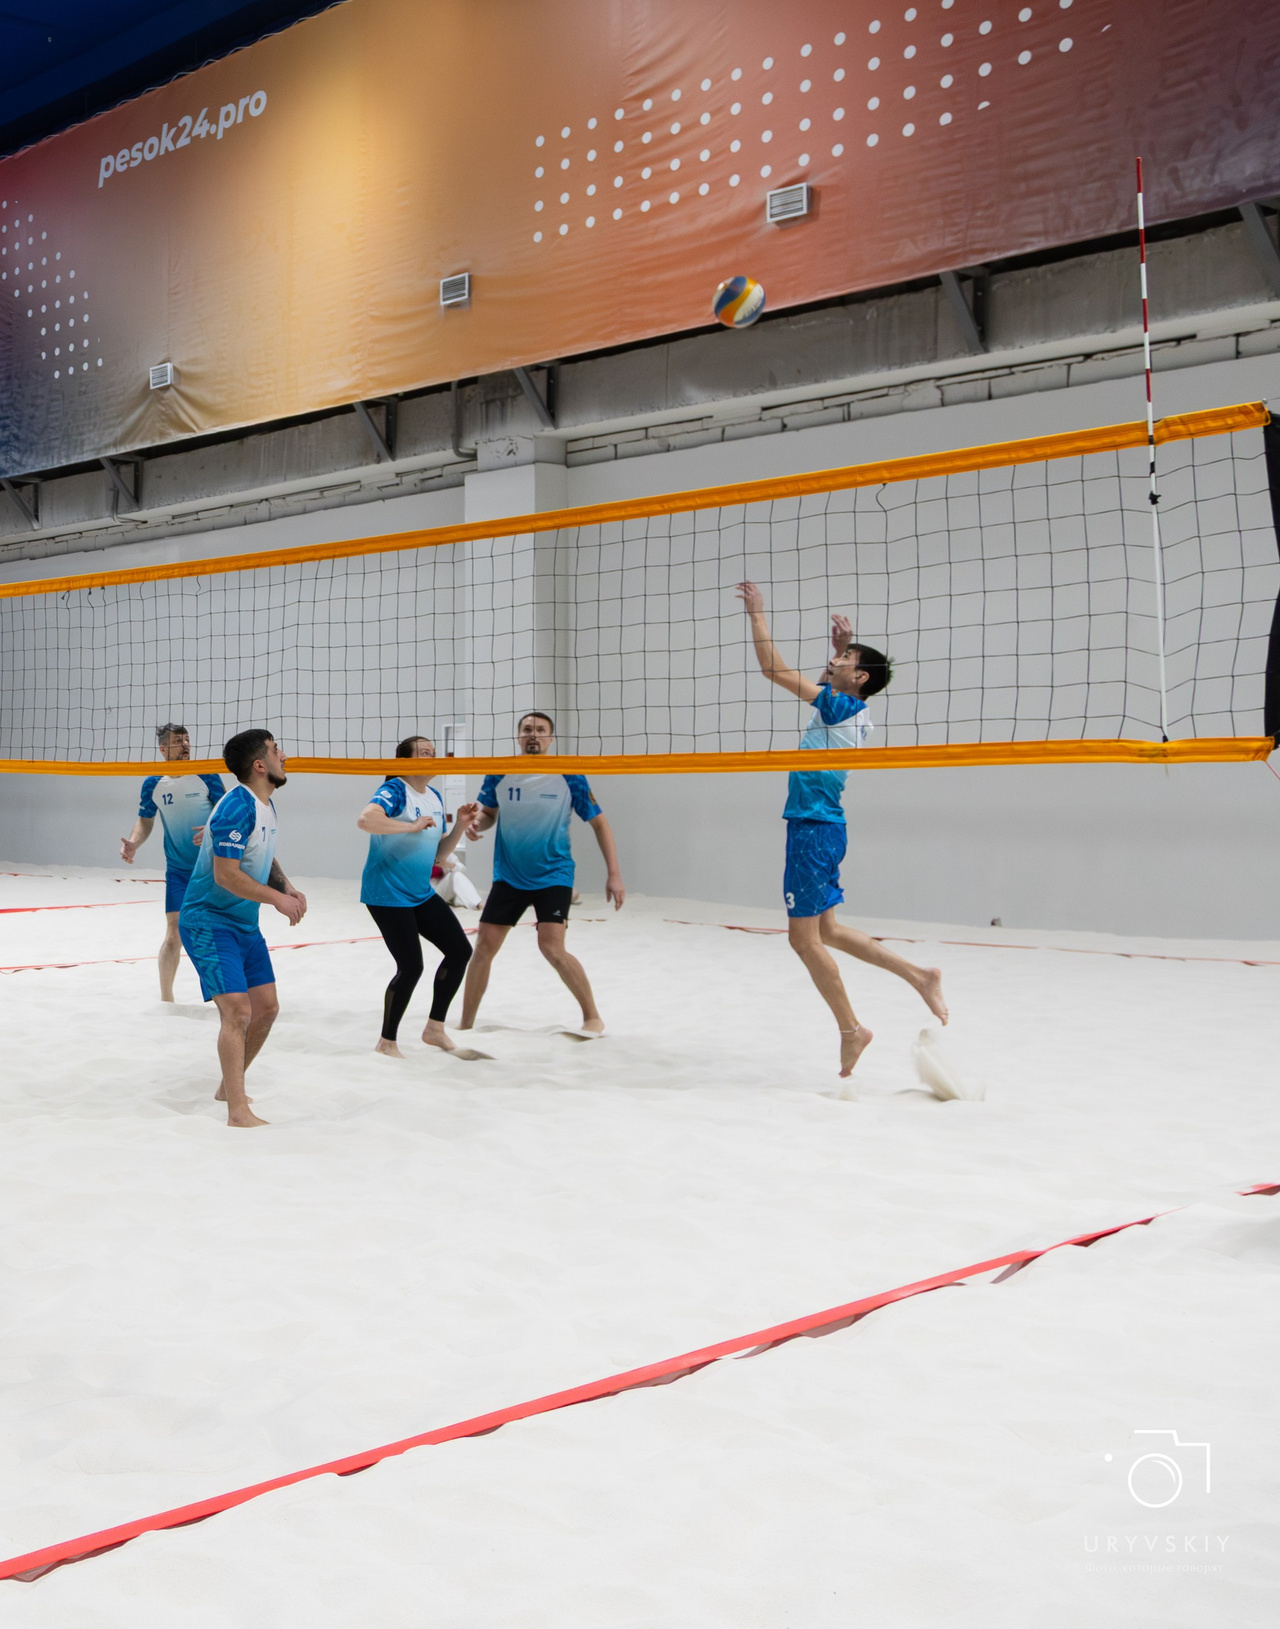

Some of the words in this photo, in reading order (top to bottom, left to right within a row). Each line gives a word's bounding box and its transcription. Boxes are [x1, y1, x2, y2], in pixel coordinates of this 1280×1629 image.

[98, 90, 267, 189] pesok24.pro
[162, 792, 174, 805] 12
[508, 787, 521, 802] 11
[786, 892, 795, 909] 3
